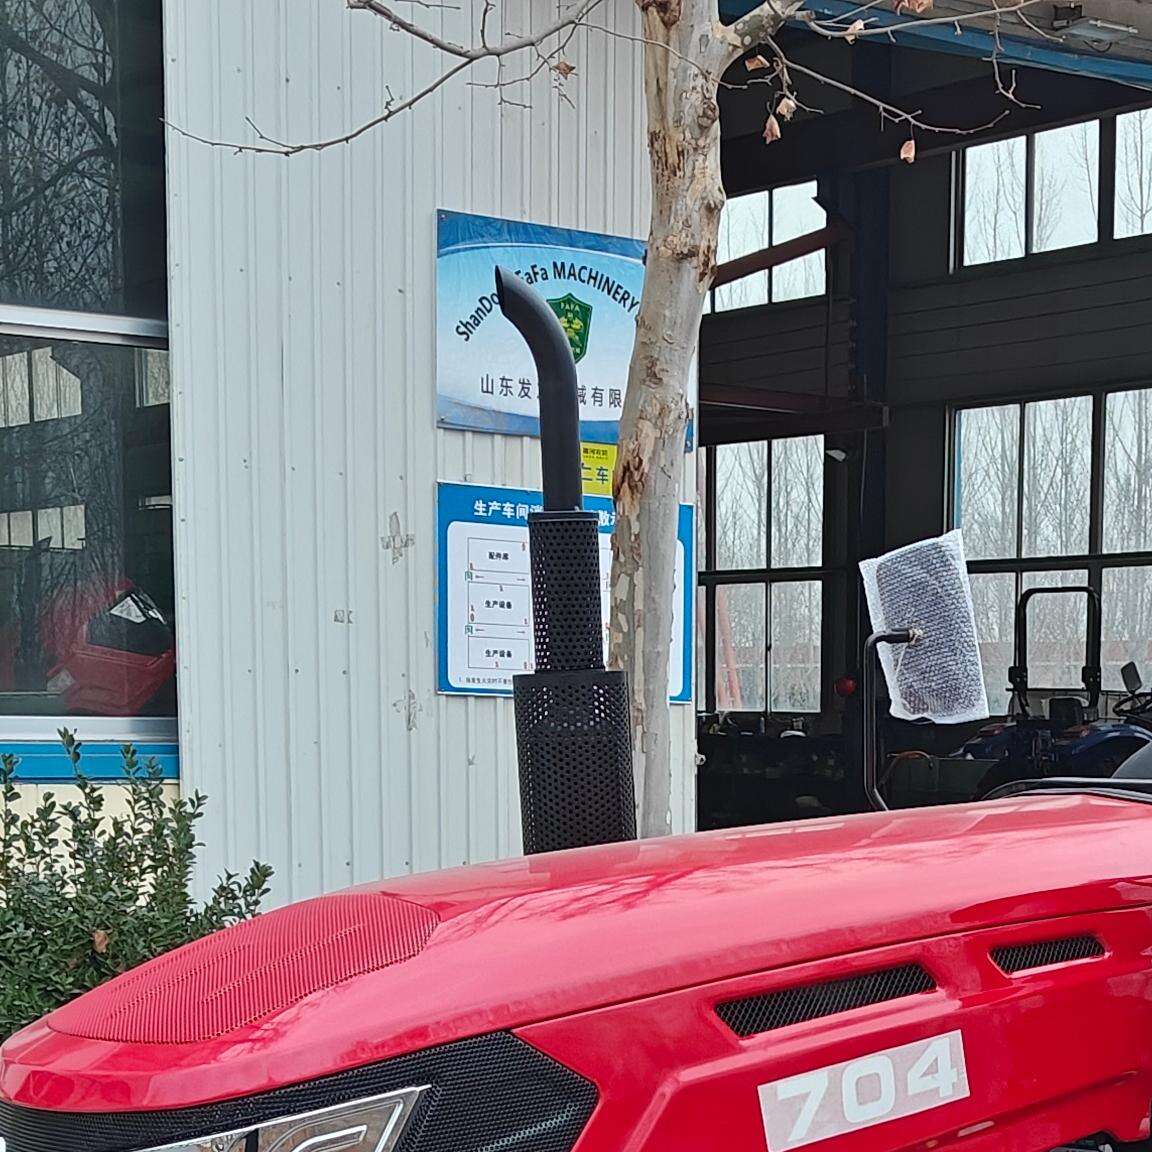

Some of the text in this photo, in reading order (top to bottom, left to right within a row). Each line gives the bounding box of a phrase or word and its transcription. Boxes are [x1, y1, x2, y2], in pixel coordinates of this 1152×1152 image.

[552, 261, 640, 313] MACHINERY
[481, 373, 622, 408] 山东发械有限
[776, 1036, 959, 1142] 704
